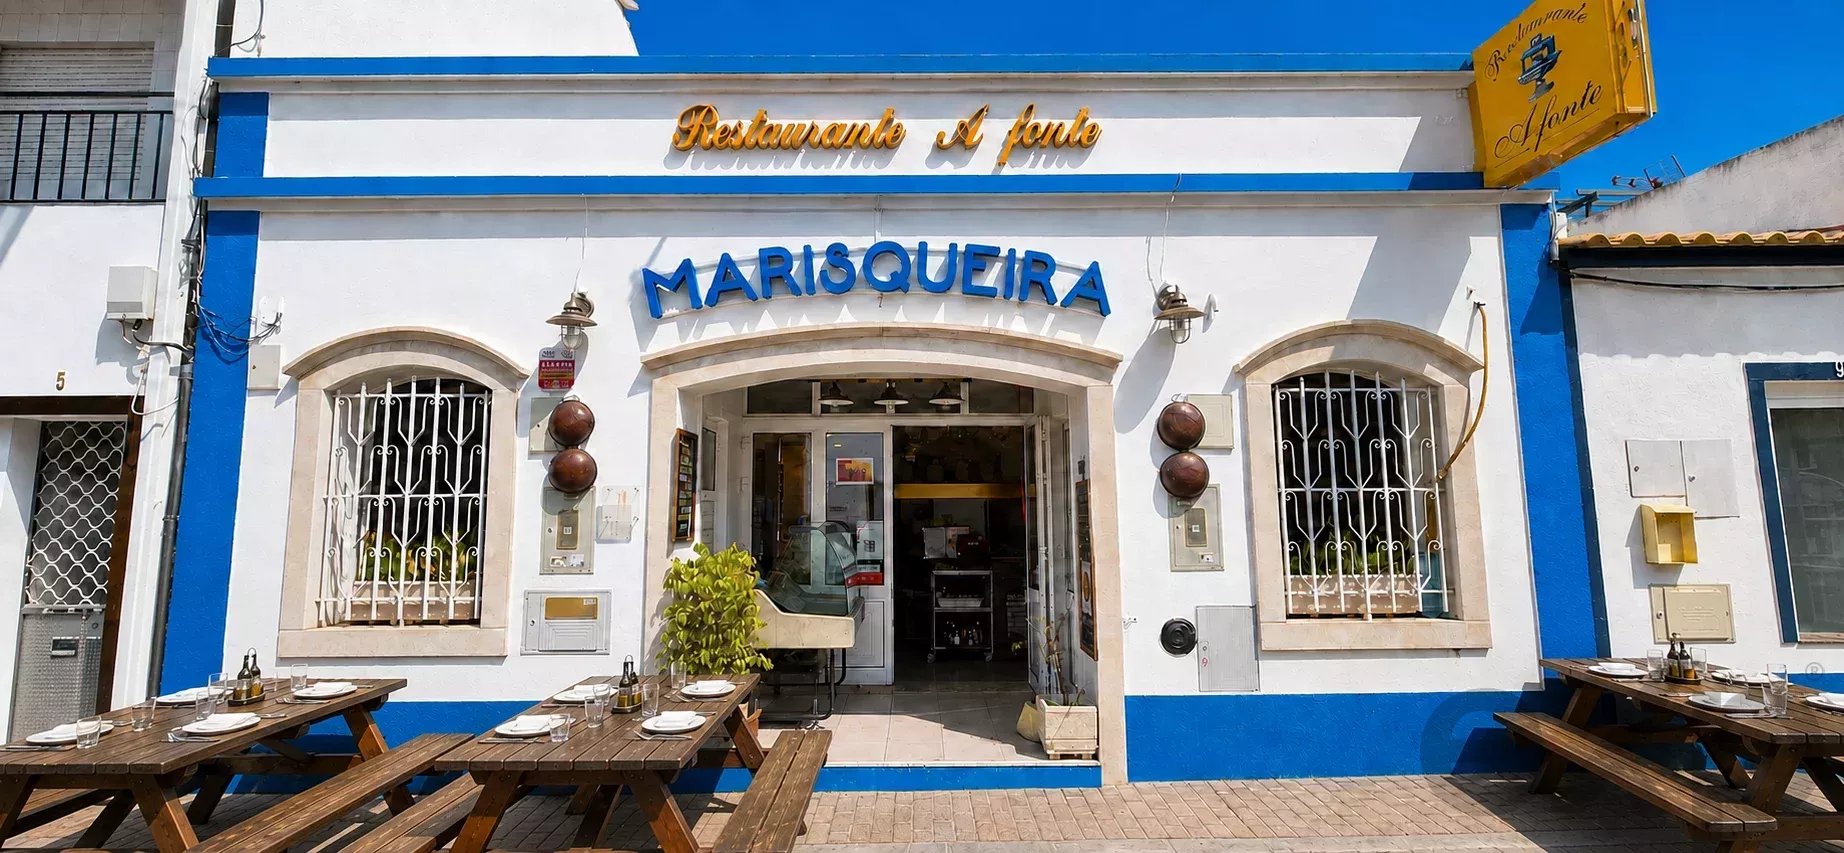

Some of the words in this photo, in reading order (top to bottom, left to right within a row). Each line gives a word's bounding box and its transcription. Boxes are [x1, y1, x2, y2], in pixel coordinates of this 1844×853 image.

[672, 103, 906, 152] Restaurante
[936, 104, 990, 150] A
[997, 102, 1103, 167] fonte
[1494, 104, 1538, 158] A
[1534, 81, 1602, 152] fonte
[642, 240, 1111, 319] MARISQUEIRA
[55, 371, 66, 391] 5
